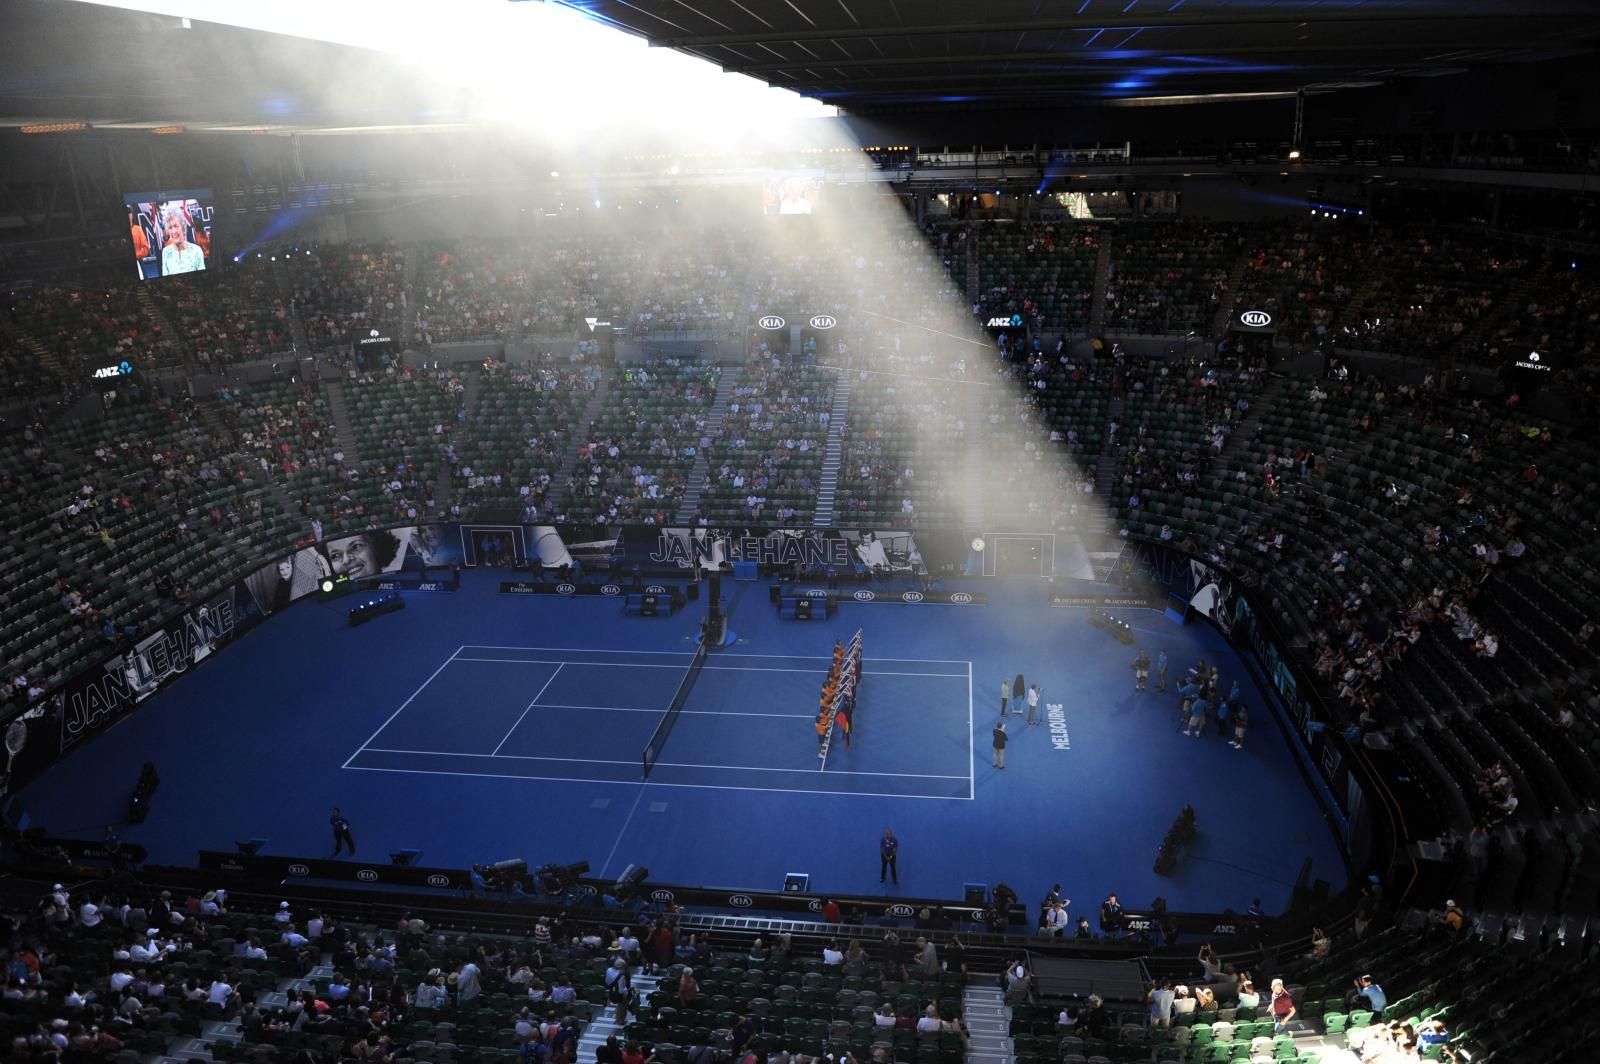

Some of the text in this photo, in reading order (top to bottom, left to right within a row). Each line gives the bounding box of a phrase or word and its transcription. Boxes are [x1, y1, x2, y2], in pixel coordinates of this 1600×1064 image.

[761, 317, 782, 328] KIA
[813, 317, 834, 328] KIA
[987, 317, 1011, 327] ANZ
[1244, 313, 1268, 325] KIA
[92, 366, 120, 378] ANZ
[650, 535, 715, 563] JAN
[723, 537, 848, 566] LEHANE
[418, 583, 437, 591] ANZ
[558, 584, 574, 593] KIA
[603, 585, 618, 594] KIA
[856, 591, 873, 600] KIA
[905, 592, 921, 601] KIA
[953, 593, 969, 602] KIA
[66, 599, 236, 734] JAN LEHANE
[1046, 703, 1072, 750] MELBOURNE
[291, 866, 307, 874] KIA
[359, 871, 376, 880] KIA
[430, 876, 447, 885] KIA
[654, 891, 671, 902] KIA
[732, 896, 750, 906] KIA
[893, 905, 911, 917] KIA
[1127, 919, 1236, 934] ANZ ANZ
